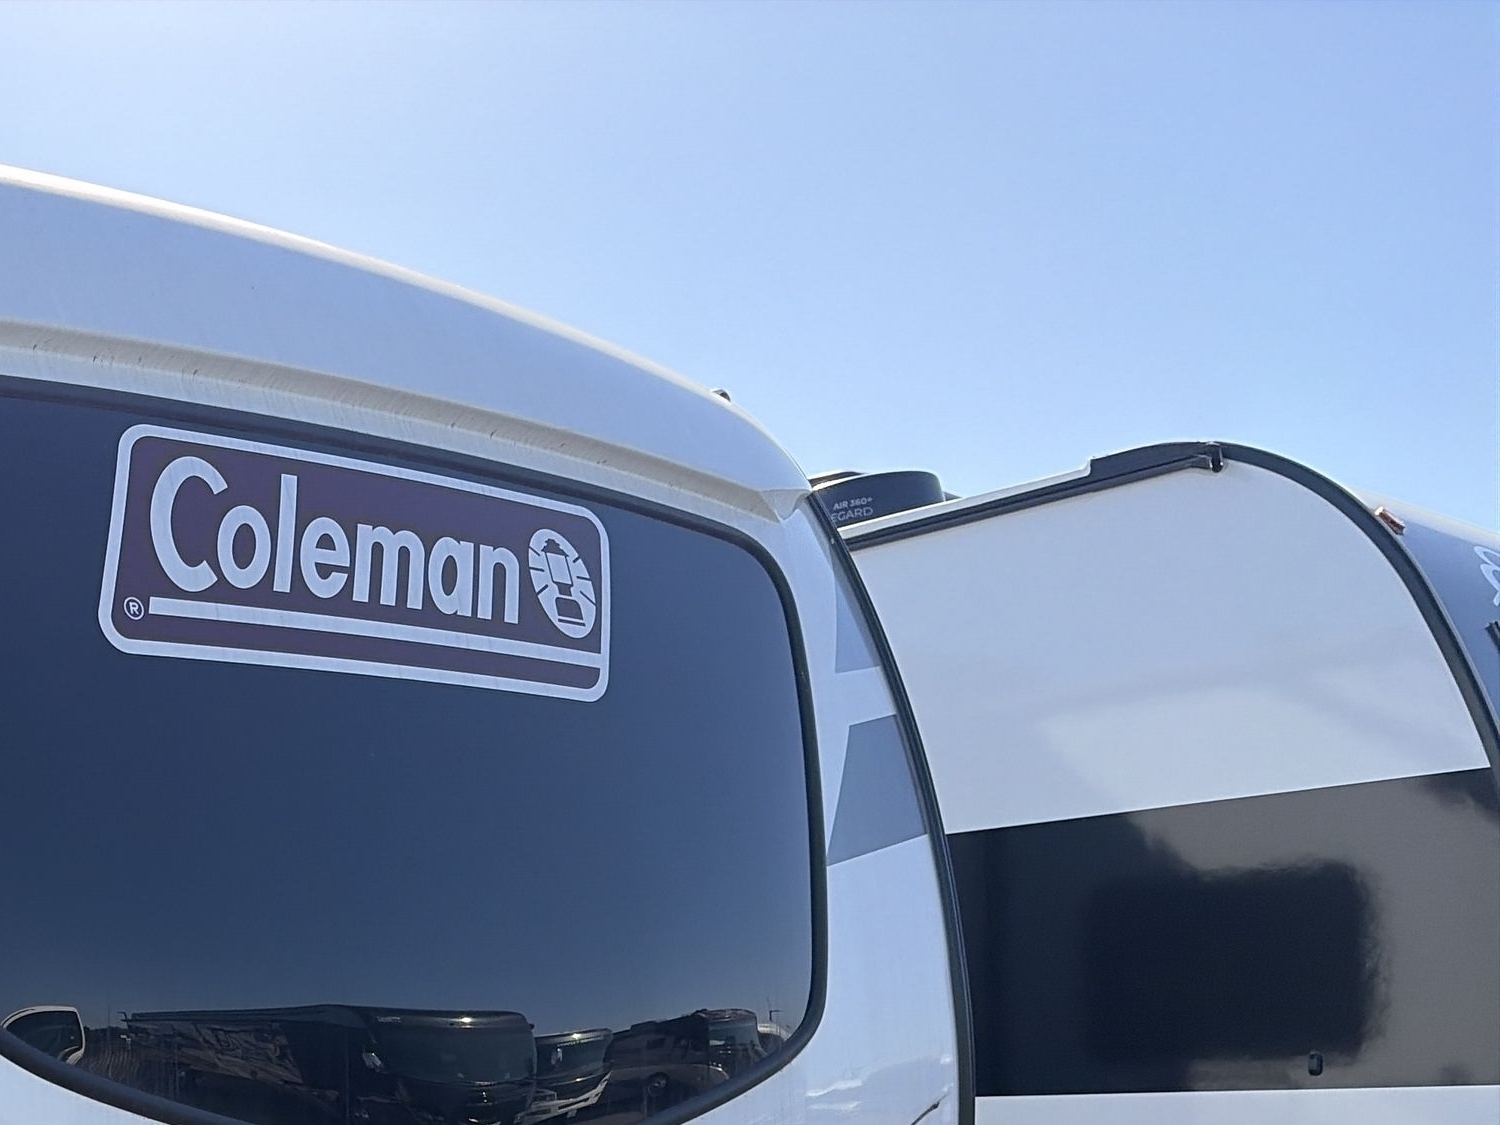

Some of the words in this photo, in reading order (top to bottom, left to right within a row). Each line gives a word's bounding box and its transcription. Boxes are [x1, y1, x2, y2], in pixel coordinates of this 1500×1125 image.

[833, 500, 849, 511] AIR
[831, 506, 874, 521] EGARD
[149, 455, 520, 625] Coleman
